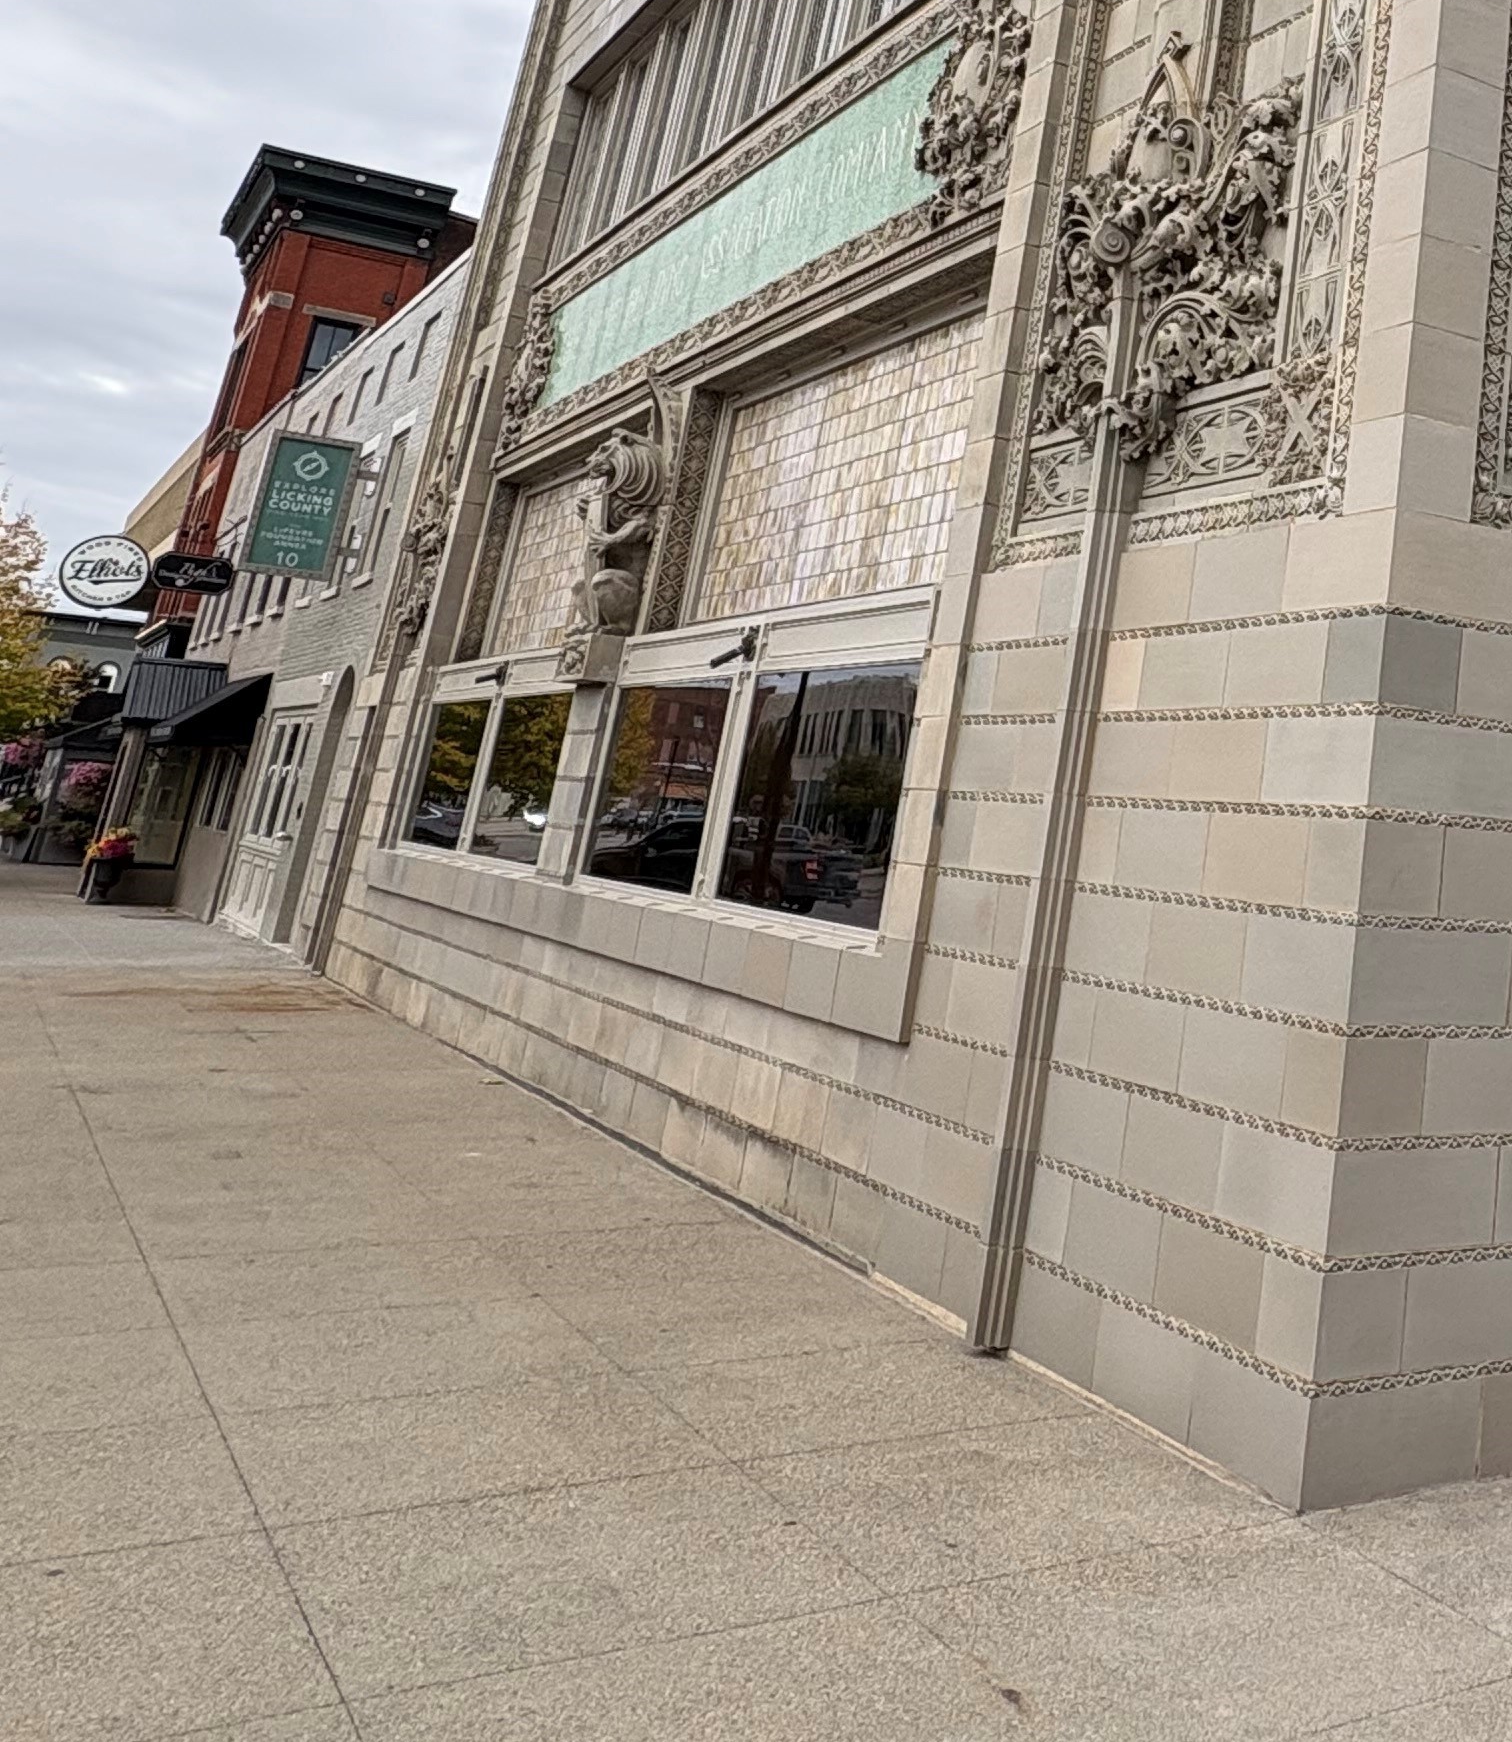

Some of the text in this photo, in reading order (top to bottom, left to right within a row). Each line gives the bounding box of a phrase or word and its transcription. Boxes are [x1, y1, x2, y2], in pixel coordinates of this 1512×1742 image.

[271, 489, 333, 506] LICKING
[268, 498, 332, 516] COUNTY
[276, 550, 299, 568] 10
